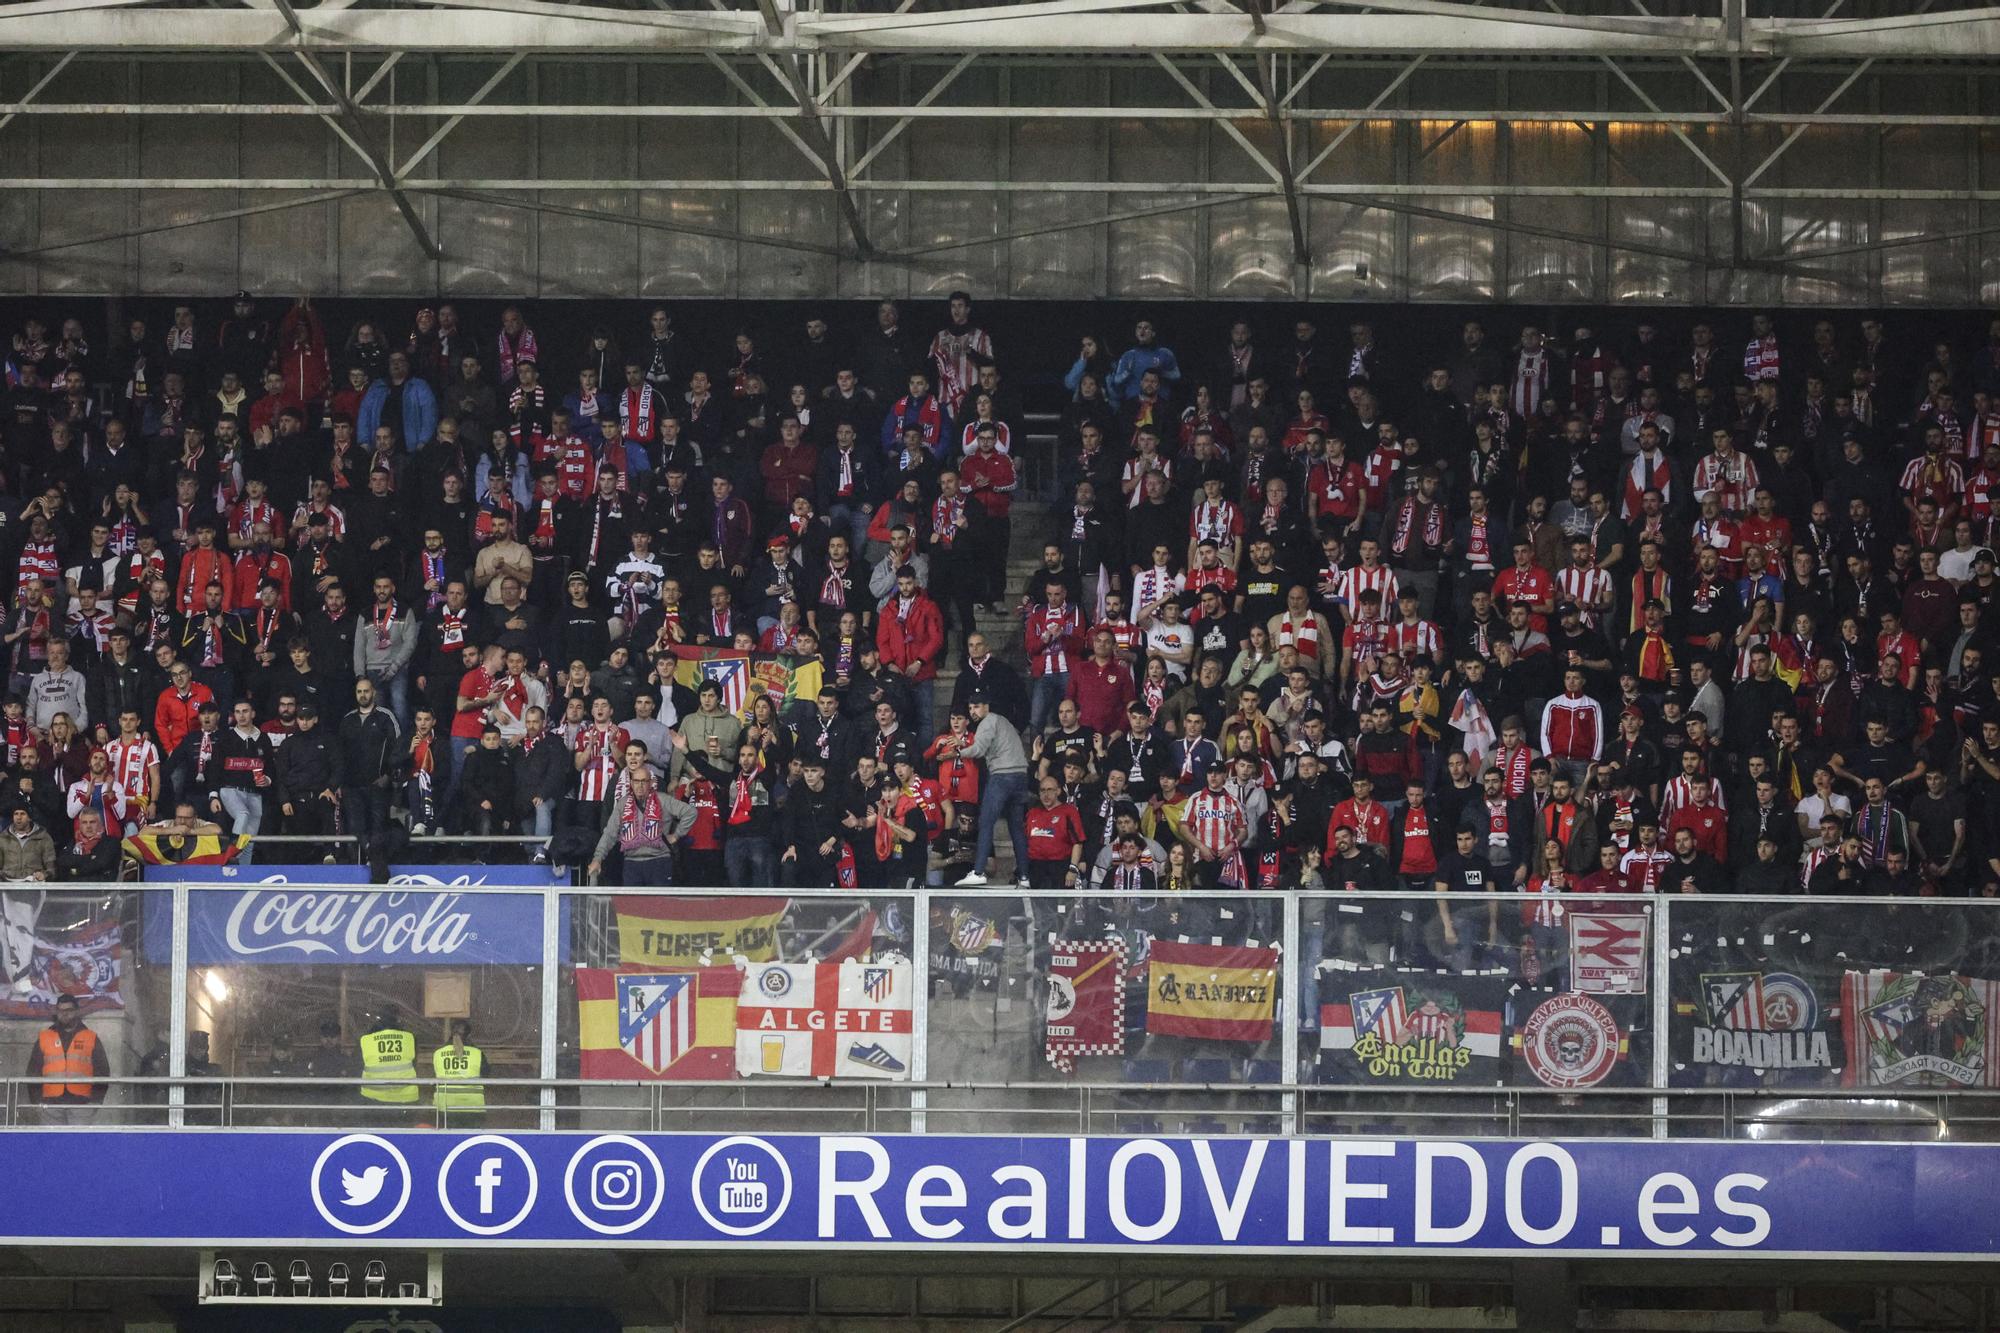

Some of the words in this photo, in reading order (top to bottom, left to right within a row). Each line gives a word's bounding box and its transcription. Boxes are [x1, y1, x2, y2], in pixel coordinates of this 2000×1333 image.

[1581, 969, 1607, 977] AWAY
[760, 1009, 893, 1032] ALGETE
[378, 1040, 402, 1053] 023
[1693, 1026, 1832, 1069] BOADILLA
[444, 1057, 468, 1070] 065
[1369, 1057, 1401, 1076] On
[1408, 1059, 1458, 1080] Tour
[727, 1158, 758, 1181] You
[724, 1186, 763, 1208] Tube
[817, 1136, 1771, 1247] RealOVIEDO.es
